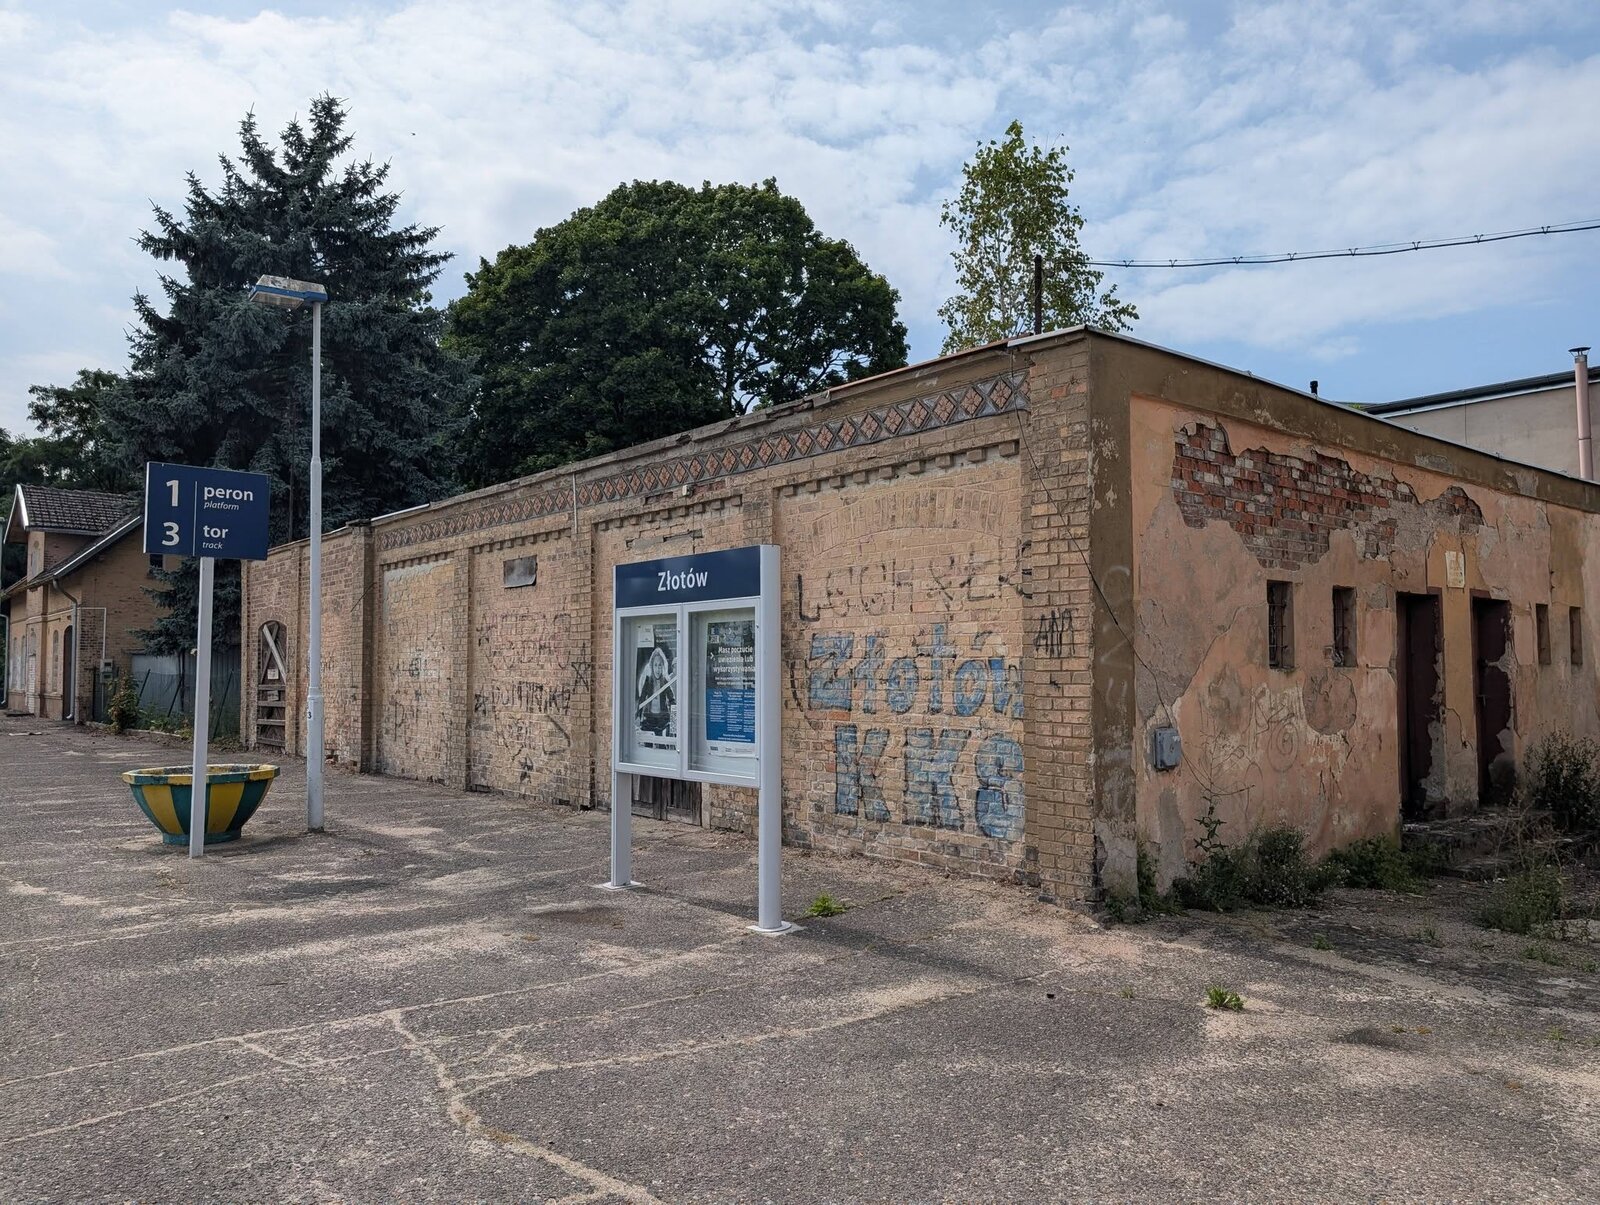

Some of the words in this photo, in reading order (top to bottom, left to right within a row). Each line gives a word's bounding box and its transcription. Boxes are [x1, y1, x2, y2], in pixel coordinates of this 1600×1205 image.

[166, 479, 179, 507] 1
[203, 486, 254, 501] peron
[203, 501, 240, 511] platform
[161, 521, 180, 546] 3
[202, 525, 229, 539] tor
[202, 541, 223, 550] track
[657, 567, 708, 592] Złotów
[307, 711, 312, 719] 3
